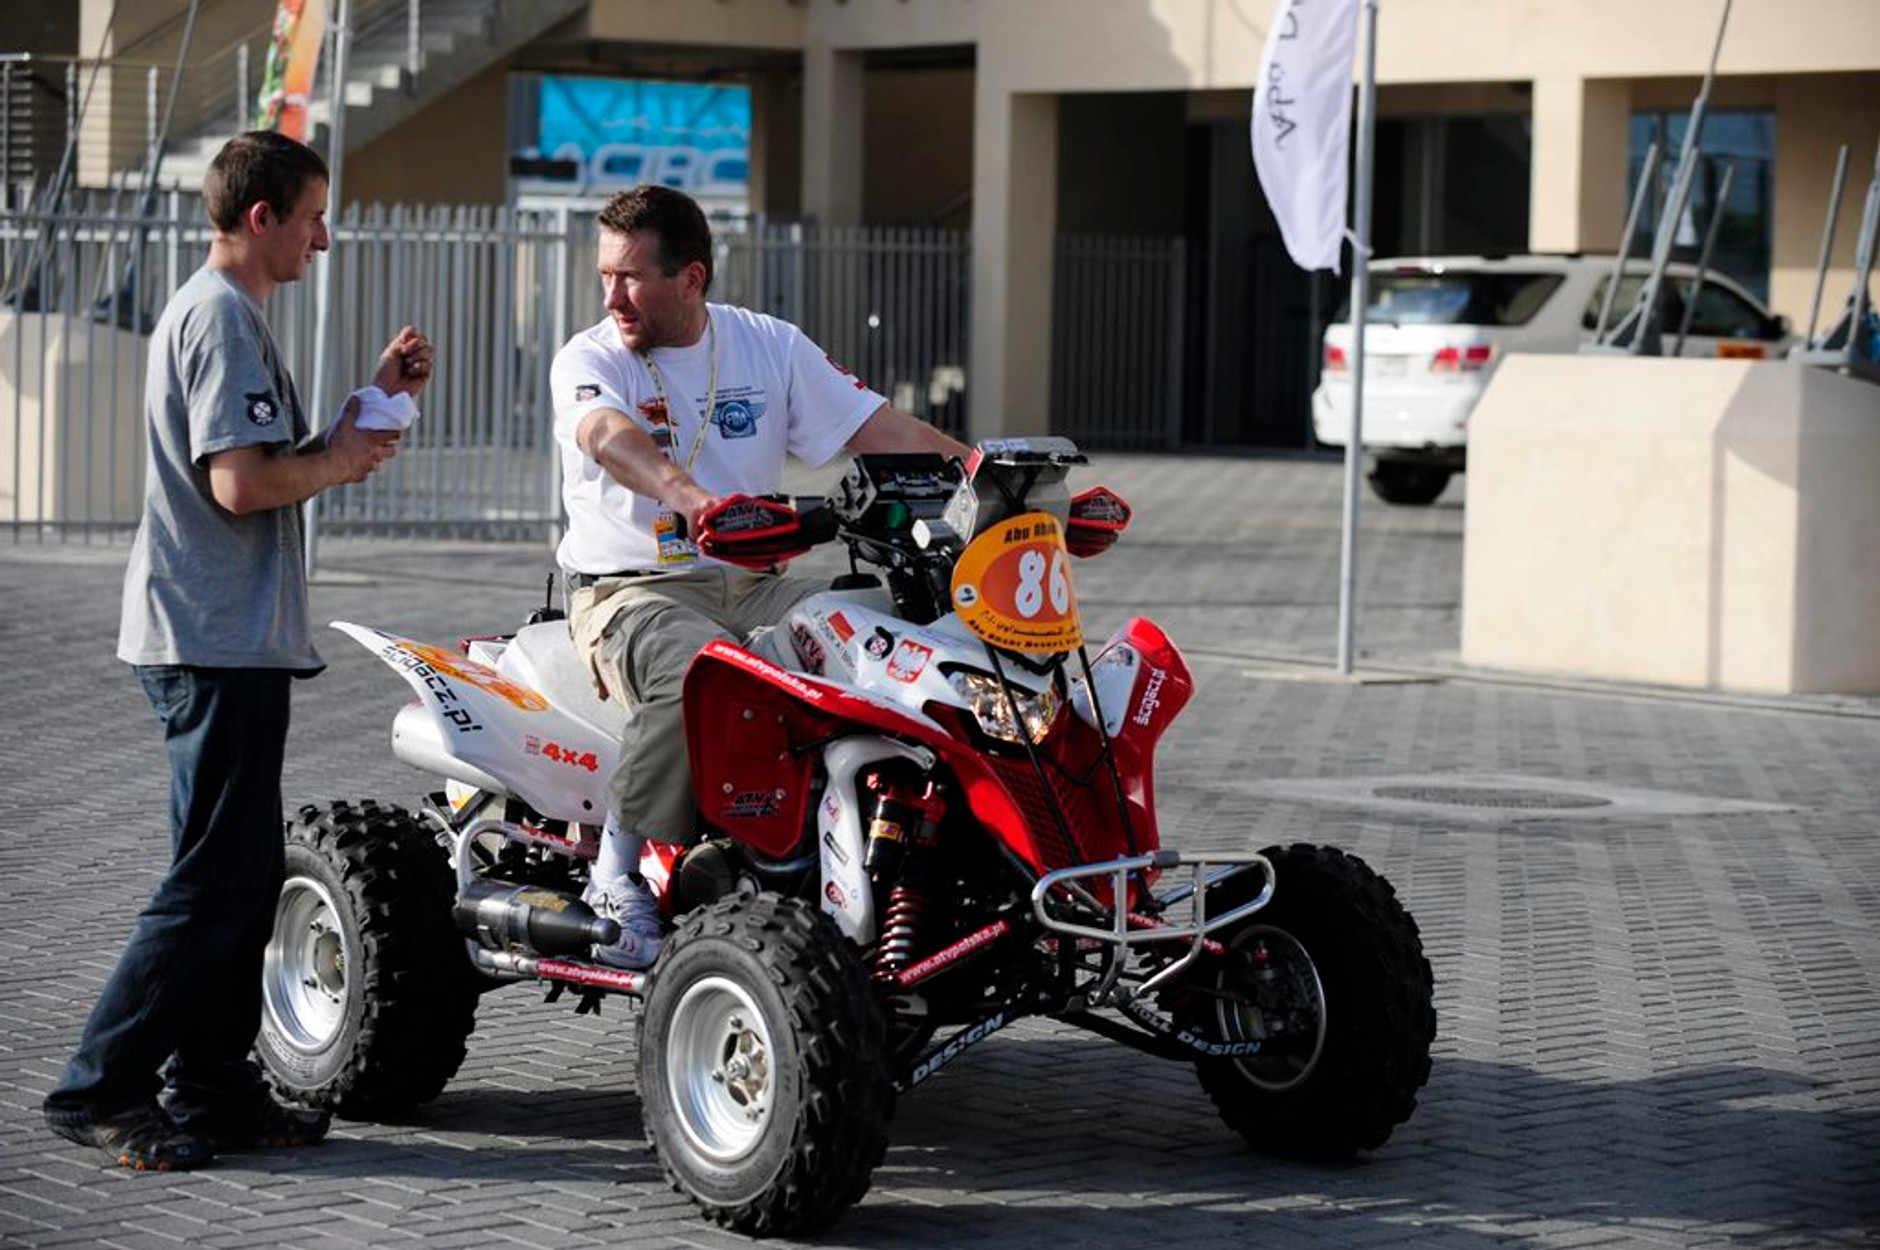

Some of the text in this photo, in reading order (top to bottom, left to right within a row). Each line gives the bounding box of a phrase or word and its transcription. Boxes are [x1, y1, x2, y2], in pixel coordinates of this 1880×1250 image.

[1014, 549, 1069, 618] 86
[541, 741, 599, 773] 4x4
[912, 1011, 1004, 1085] DESIGN
[1176, 1029, 1261, 1056] DESIGN
